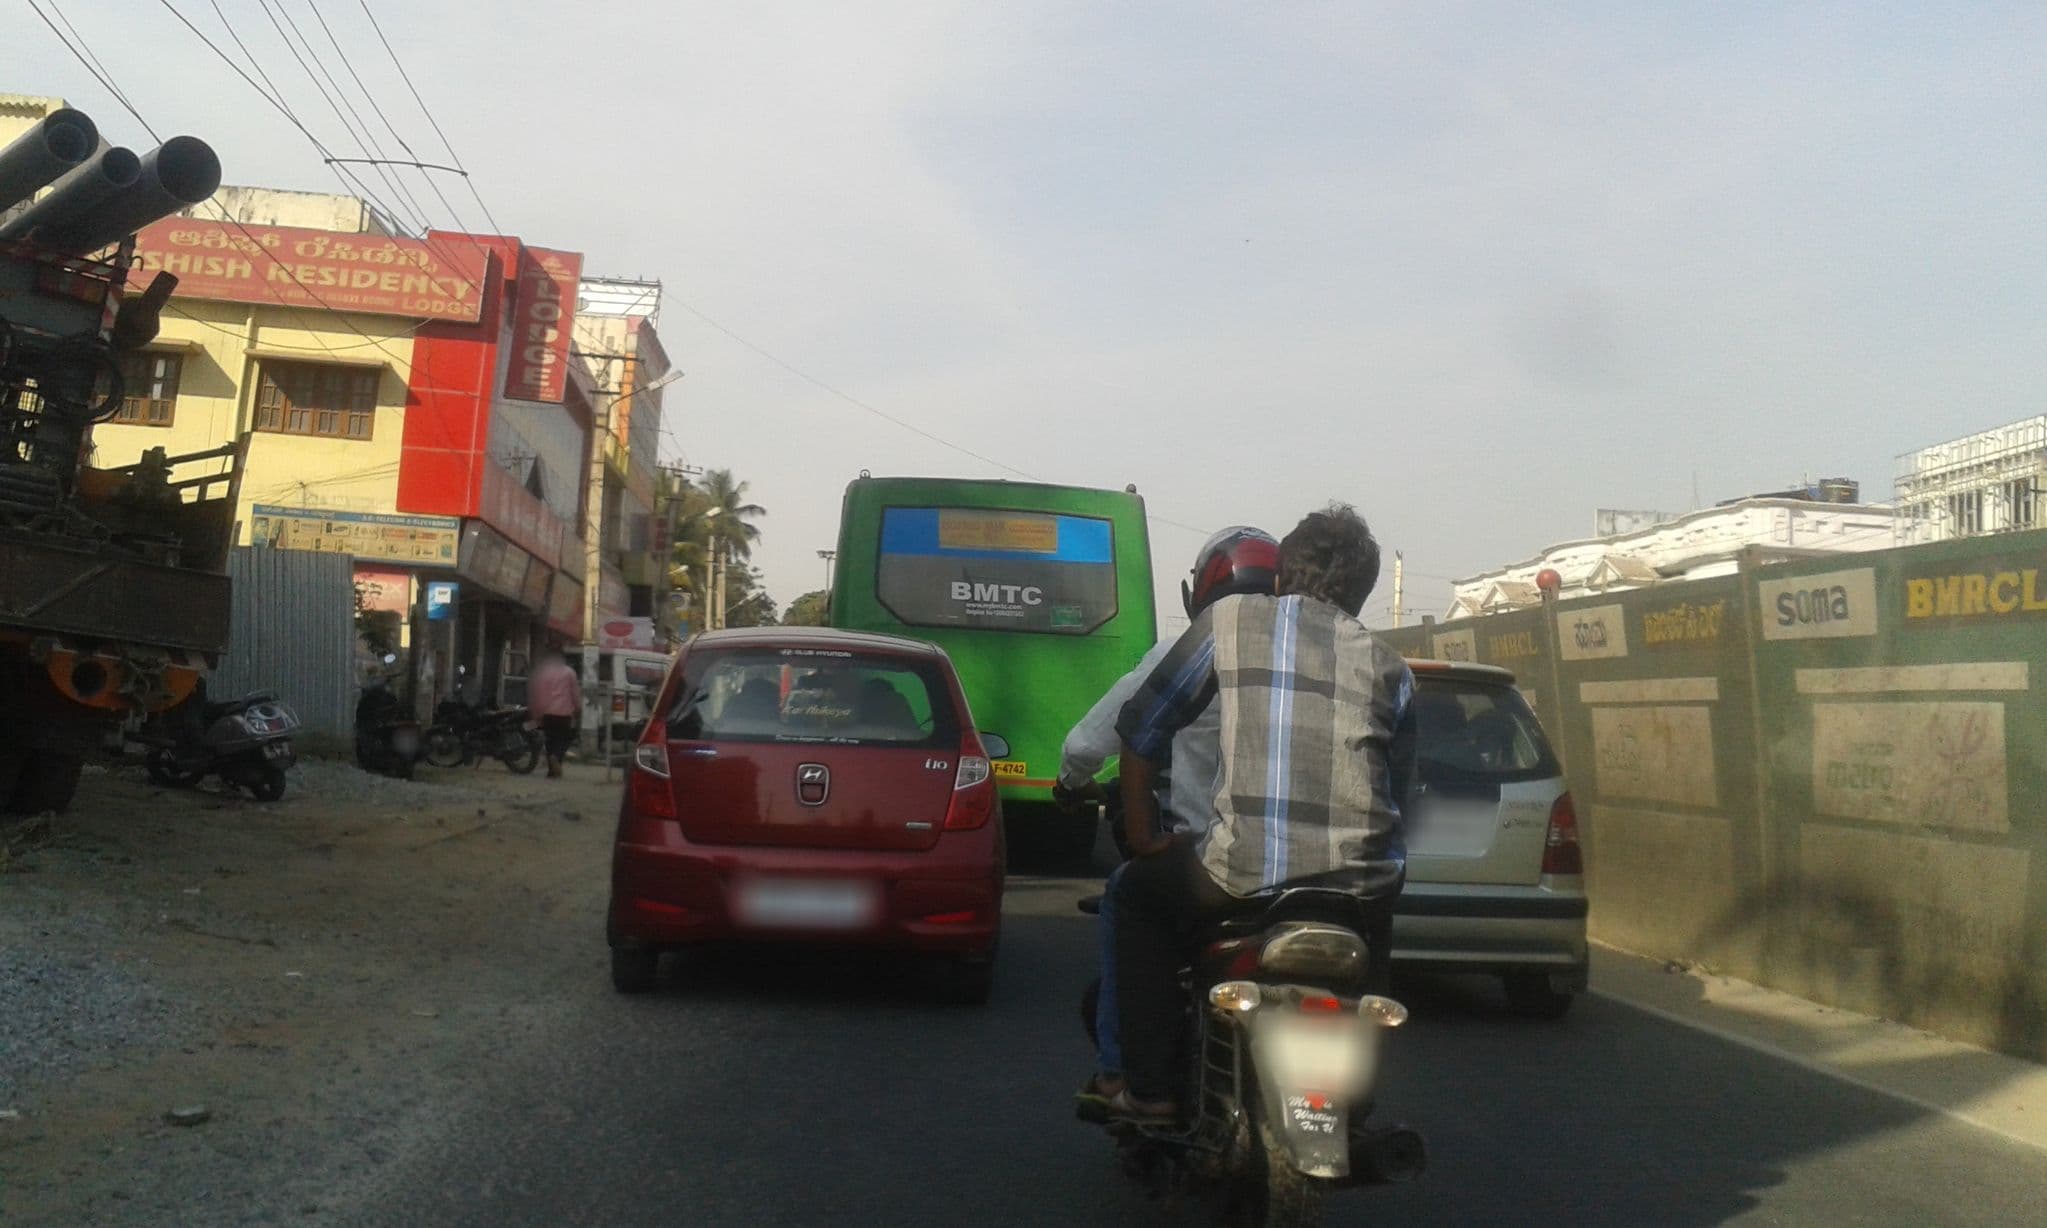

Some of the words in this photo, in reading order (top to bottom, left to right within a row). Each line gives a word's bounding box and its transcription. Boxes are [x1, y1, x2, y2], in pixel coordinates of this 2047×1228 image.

[266, 261, 477, 300] RESIDENCY
[402, 296, 478, 317] LODGE
[521, 279, 563, 388] LODGE
[951, 581, 1042, 606] BMTC
[1906, 568, 2047, 619] BMRCL
